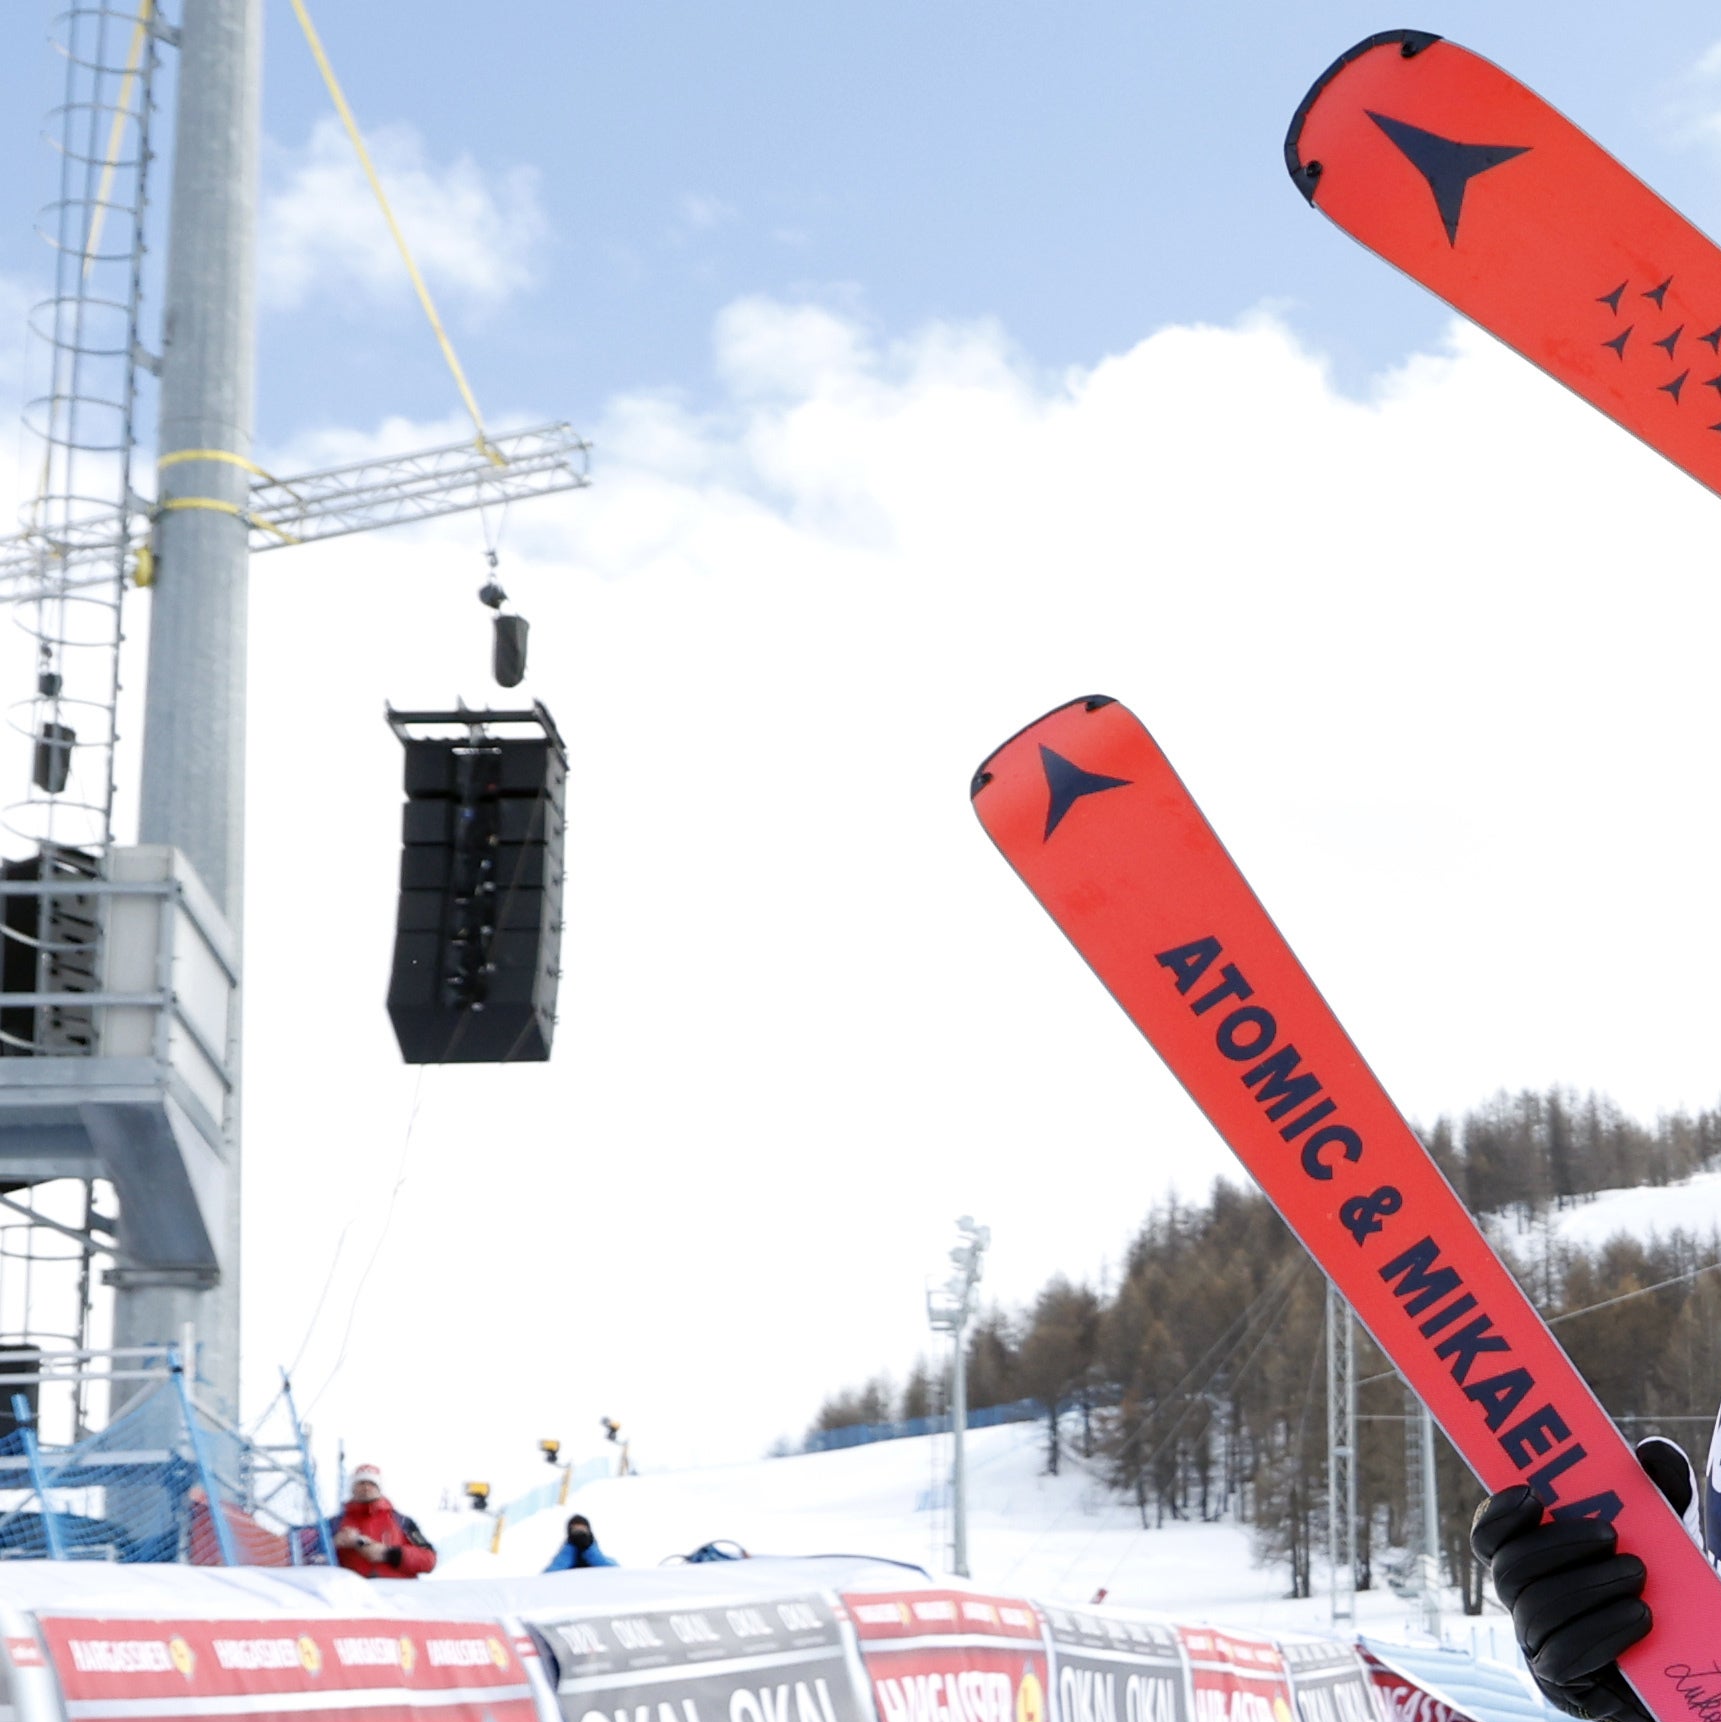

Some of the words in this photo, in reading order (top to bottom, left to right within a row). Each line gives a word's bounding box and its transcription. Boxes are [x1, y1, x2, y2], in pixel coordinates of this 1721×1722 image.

[1155, 935, 1362, 1181] ATOMIC
[1339, 1185, 1402, 1247] &
[1379, 1236, 1624, 1522] MIKAELA
